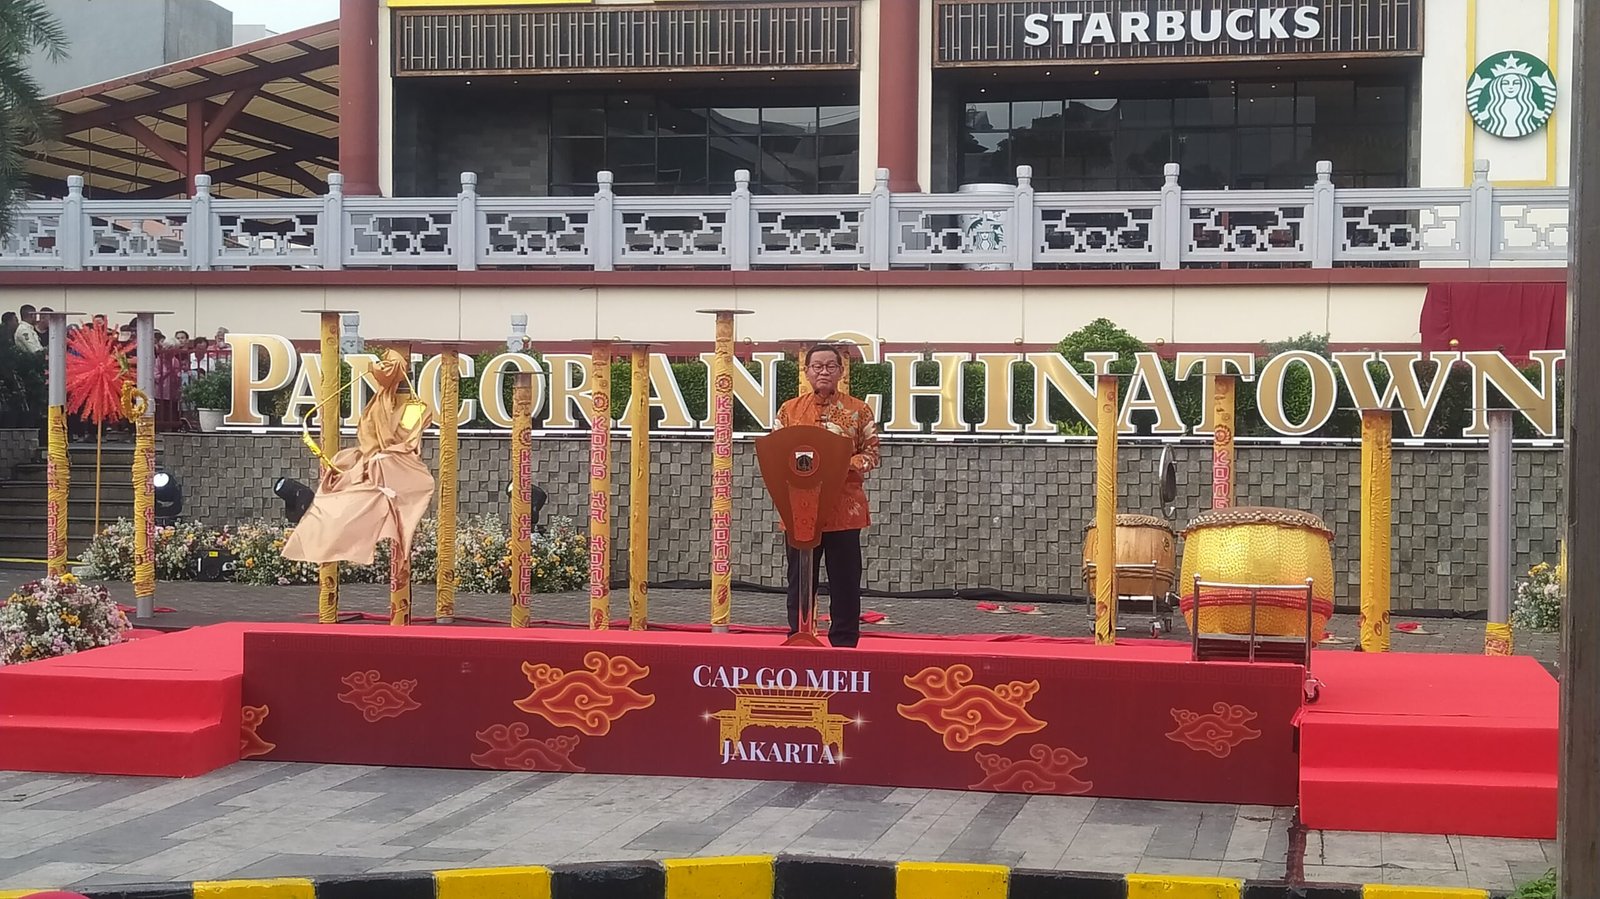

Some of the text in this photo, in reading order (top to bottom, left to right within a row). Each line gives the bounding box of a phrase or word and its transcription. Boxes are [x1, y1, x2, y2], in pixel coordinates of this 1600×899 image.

[1023, 6, 1321, 46] STARBUCKS
[591, 416, 607, 479] KONG
[713, 394, 732, 576] KONG HA HONG
[1213, 450, 1231, 509] KONG
[692, 664, 872, 693] CAP GO MEH
[721, 740, 837, 765] JAKARTA
